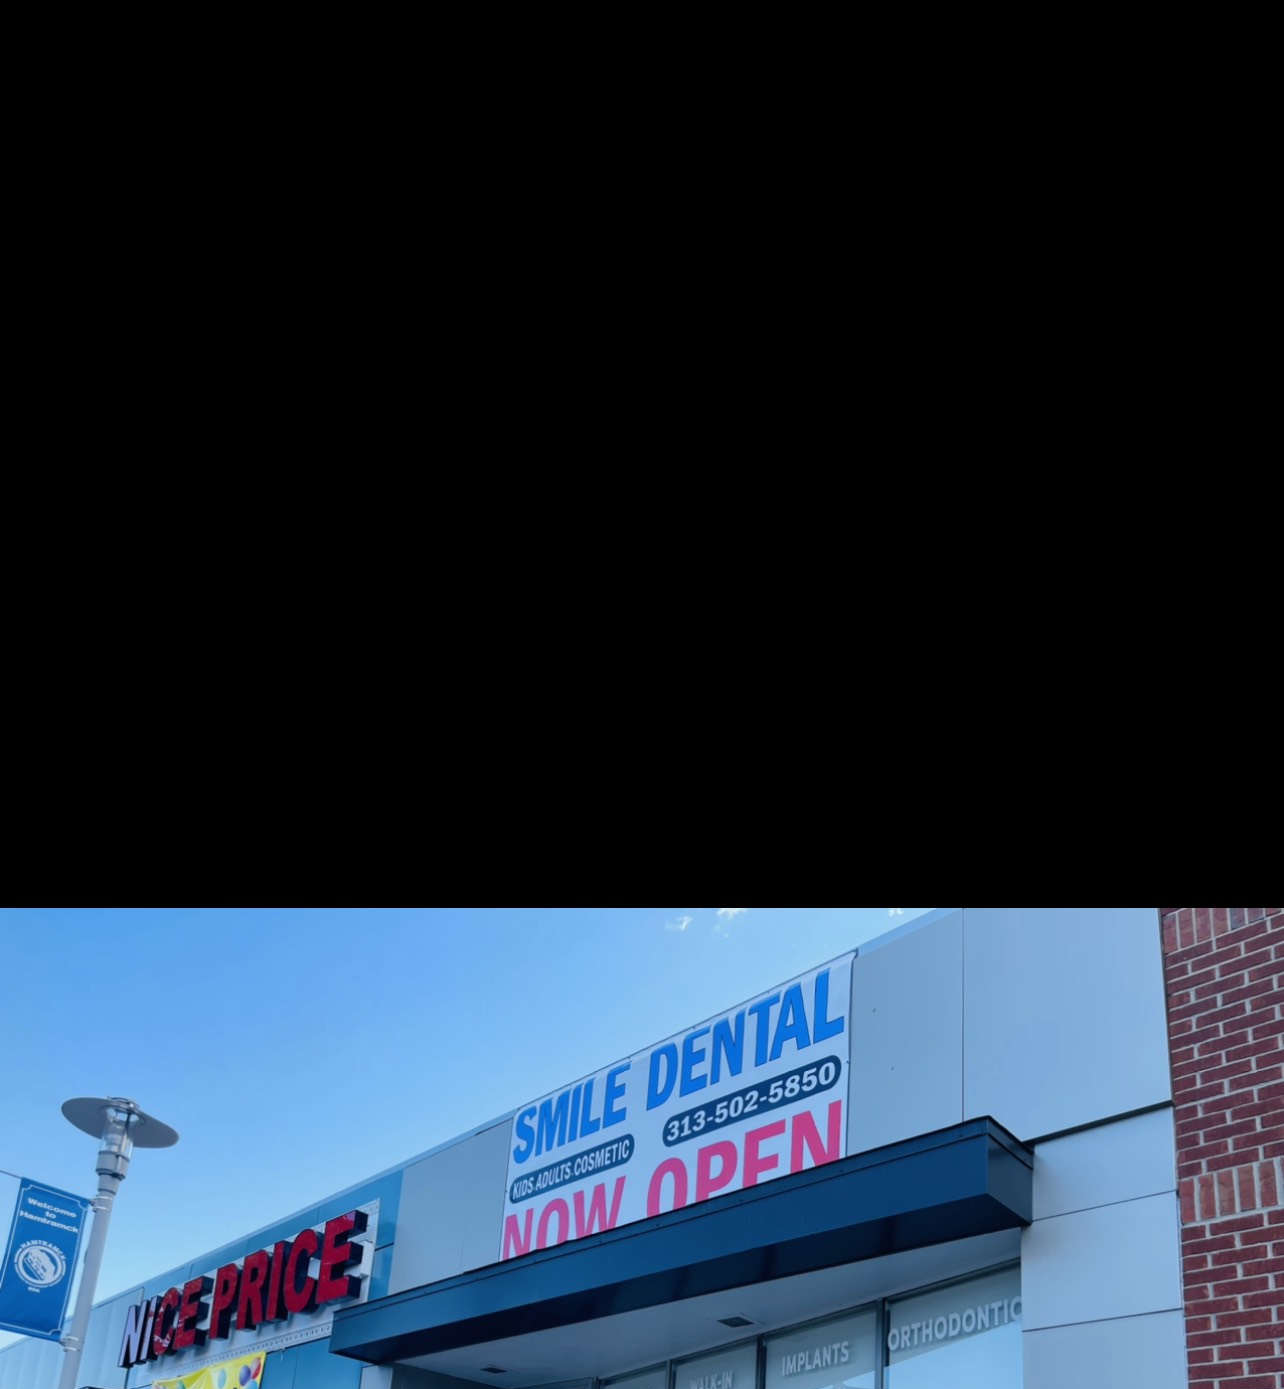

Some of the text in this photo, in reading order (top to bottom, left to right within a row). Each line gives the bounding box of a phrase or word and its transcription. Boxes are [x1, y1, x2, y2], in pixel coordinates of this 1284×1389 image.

[513, 967, 844, 1164] SMILE DENTAL
[666, 1061, 836, 1142] 313-502-5850
[502, 1099, 842, 1260] NOW OPEN
[19, 1210, 79, 1234] Hamtramck
[27, 1197, 77, 1219] Welcome
[45, 1210, 57, 1220] to
[20, 1239, 67, 1261] HAMTRAMCK
[118, 1209, 364, 1367] NICE PRICE
[781, 1341, 849, 1376] IMPLANTS
